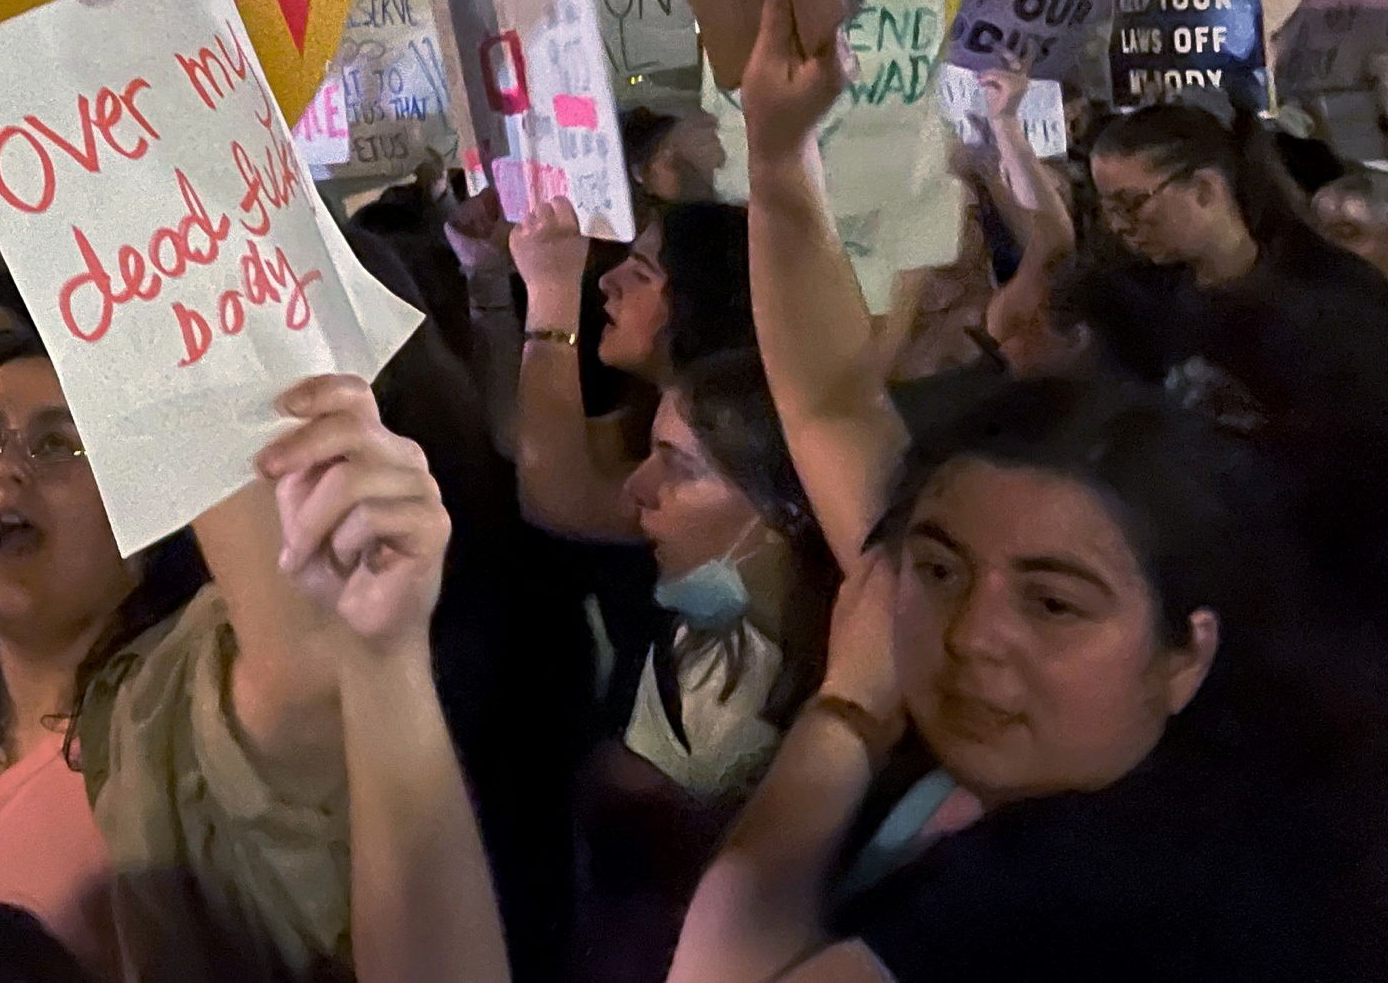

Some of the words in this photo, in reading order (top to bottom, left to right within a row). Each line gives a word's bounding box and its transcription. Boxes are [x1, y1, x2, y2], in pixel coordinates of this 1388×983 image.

[1120, 26, 1163, 54] LAWS
[1173, 25, 1229, 53] OFF
[173, 20, 273, 128] my
[389, 95, 427, 122] THAT
[59, 168, 231, 342] dead
